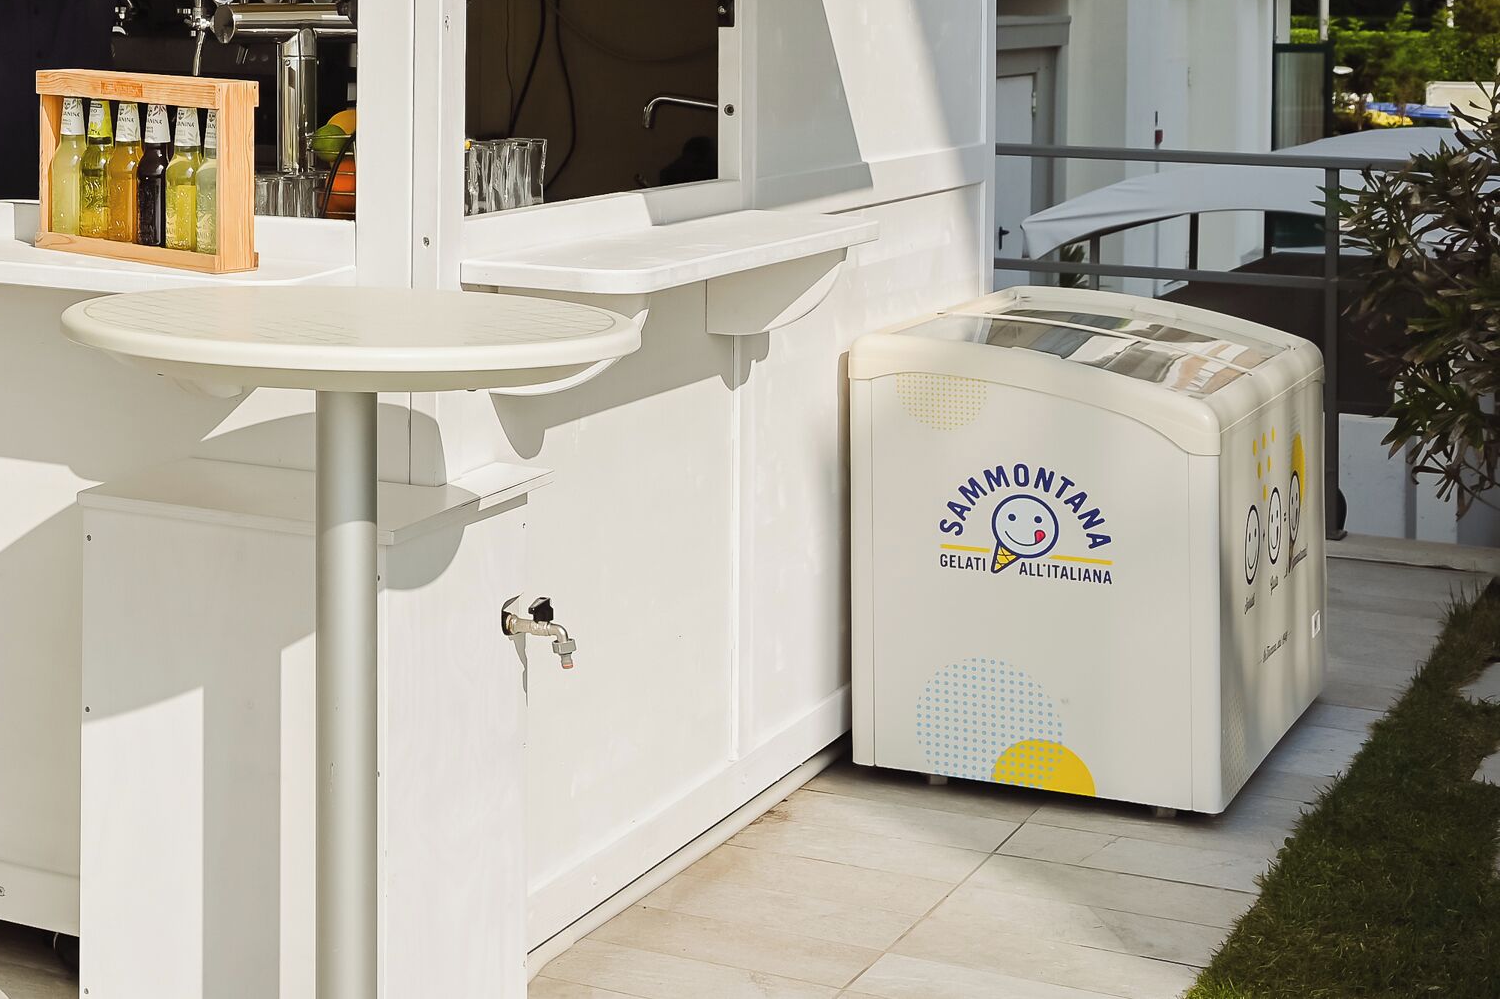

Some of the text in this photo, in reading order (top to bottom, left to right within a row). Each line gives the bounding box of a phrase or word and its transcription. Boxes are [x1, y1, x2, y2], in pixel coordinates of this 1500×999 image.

[939, 463, 1112, 549] SAMMONTANA
[939, 553, 1113, 585] GELATI ALL'ITALIANA
